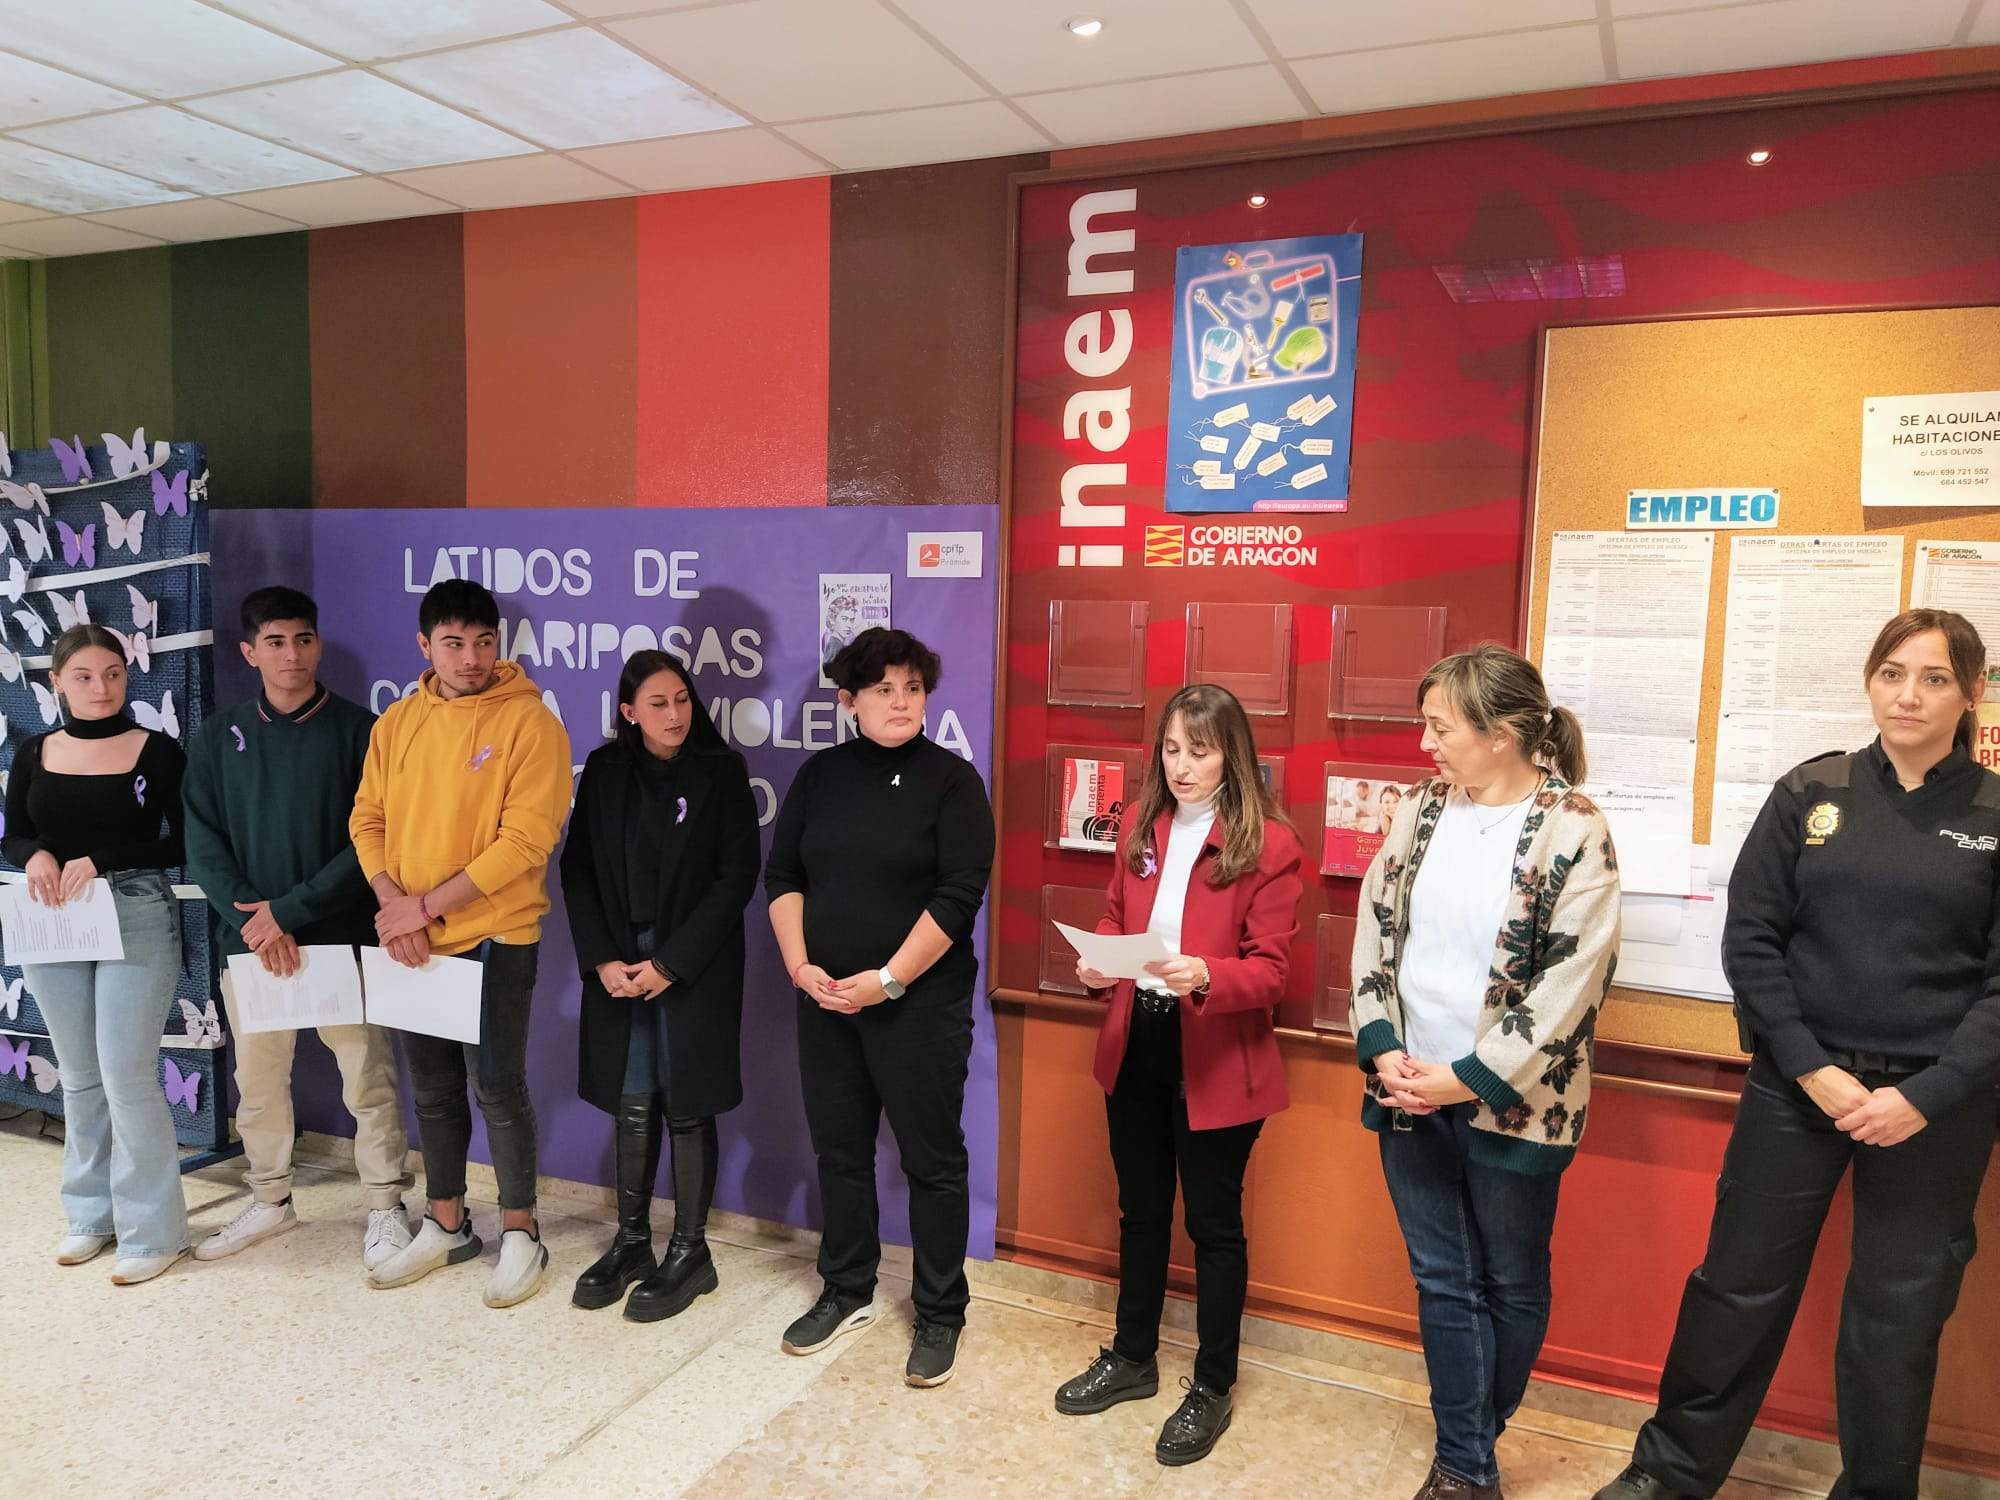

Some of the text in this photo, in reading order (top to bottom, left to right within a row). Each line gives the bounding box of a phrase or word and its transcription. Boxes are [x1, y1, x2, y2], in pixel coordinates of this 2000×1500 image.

[1058, 188, 1137, 566] inaem
[1900, 415, 1920, 426] SE
[1629, 494, 1775, 522] EMPLEO
[1190, 525, 1303, 545] GOBIERNO
[1188, 547, 1318, 566] DE ARAGON
[404, 547, 701, 599] LATIDOS DE
[1088, 774, 1097, 812] inaem
[1939, 829, 1998, 846] POLICI
[1958, 841, 1996, 851] CNP
